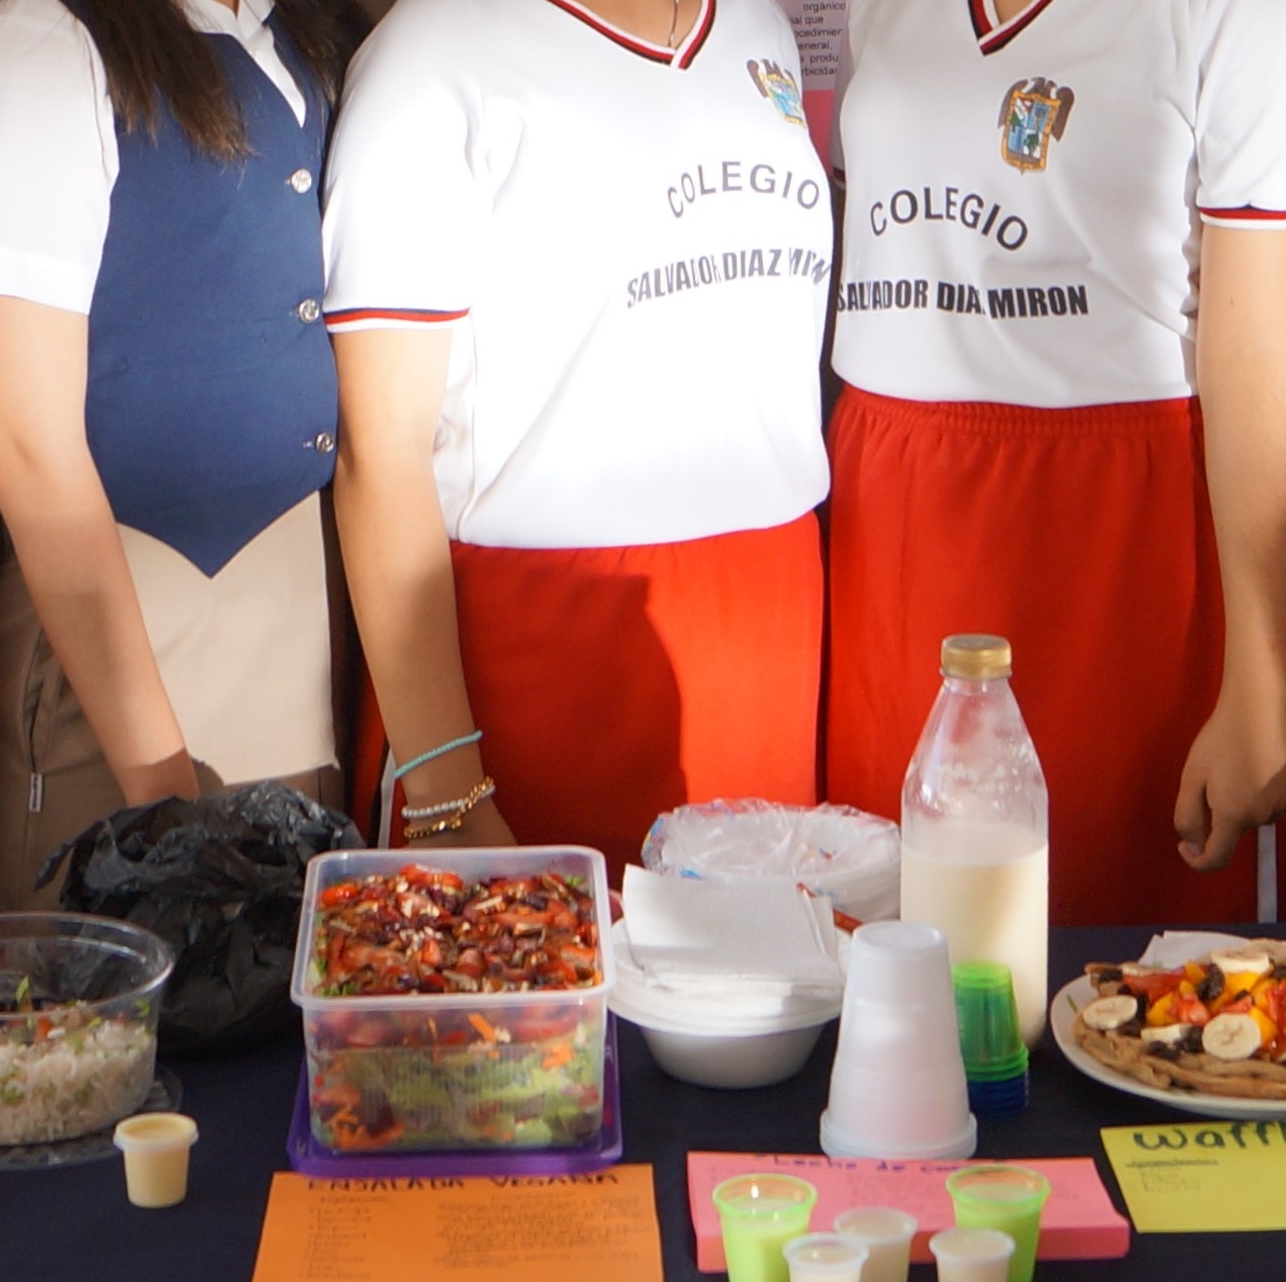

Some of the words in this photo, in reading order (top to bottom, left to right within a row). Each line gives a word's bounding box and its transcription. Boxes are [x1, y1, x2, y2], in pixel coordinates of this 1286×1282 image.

[803, 2, 846, 12] orgánico
[805, 17, 824, 26] que
[667, 161, 820, 218] COLEGIO
[870, 186, 1028, 251] COLEGIO
[722, 248, 782, 282] DIAZ
[937, 281, 985, 316] DIA
[987, 284, 1090, 320] MIRON
